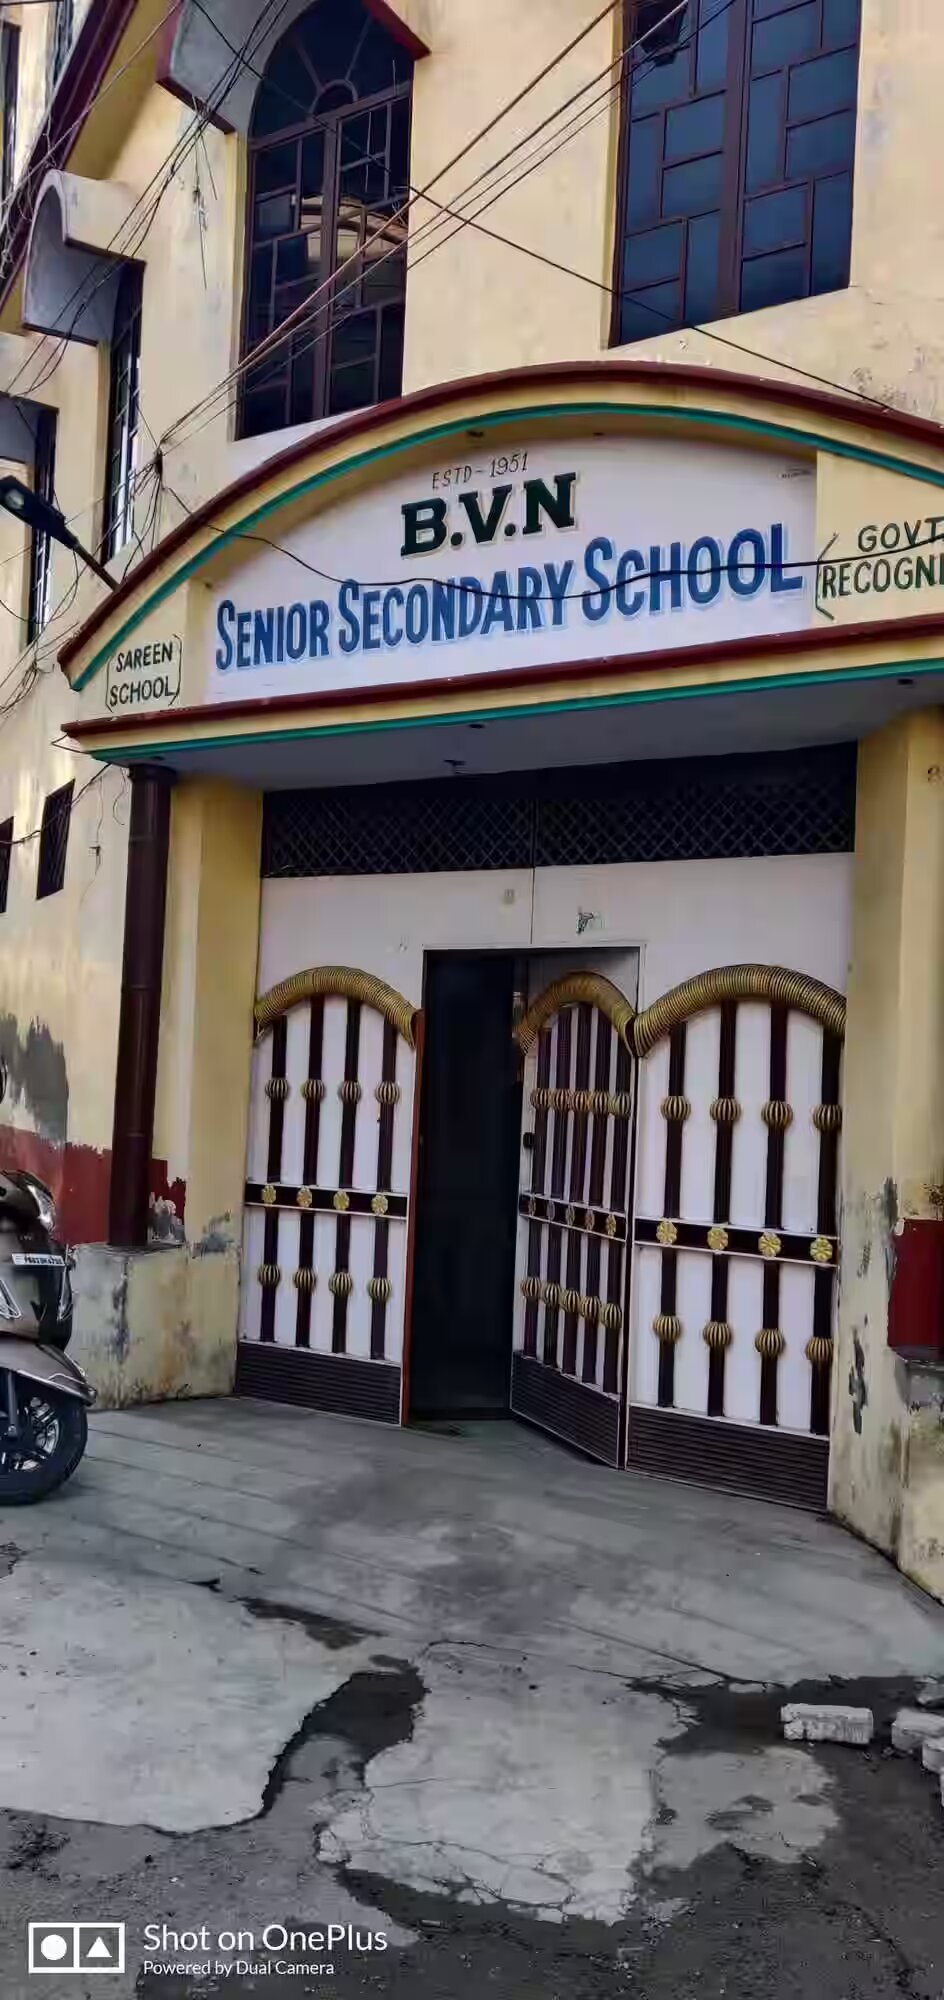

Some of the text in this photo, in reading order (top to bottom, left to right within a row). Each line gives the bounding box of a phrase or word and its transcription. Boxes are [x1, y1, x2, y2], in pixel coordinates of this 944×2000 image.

[215, 523, 803, 670] SENIOR SECONDARY SCHOOL
[116, 641, 173, 672] SAREEN
[109, 675, 177, 707] SCHOOL
